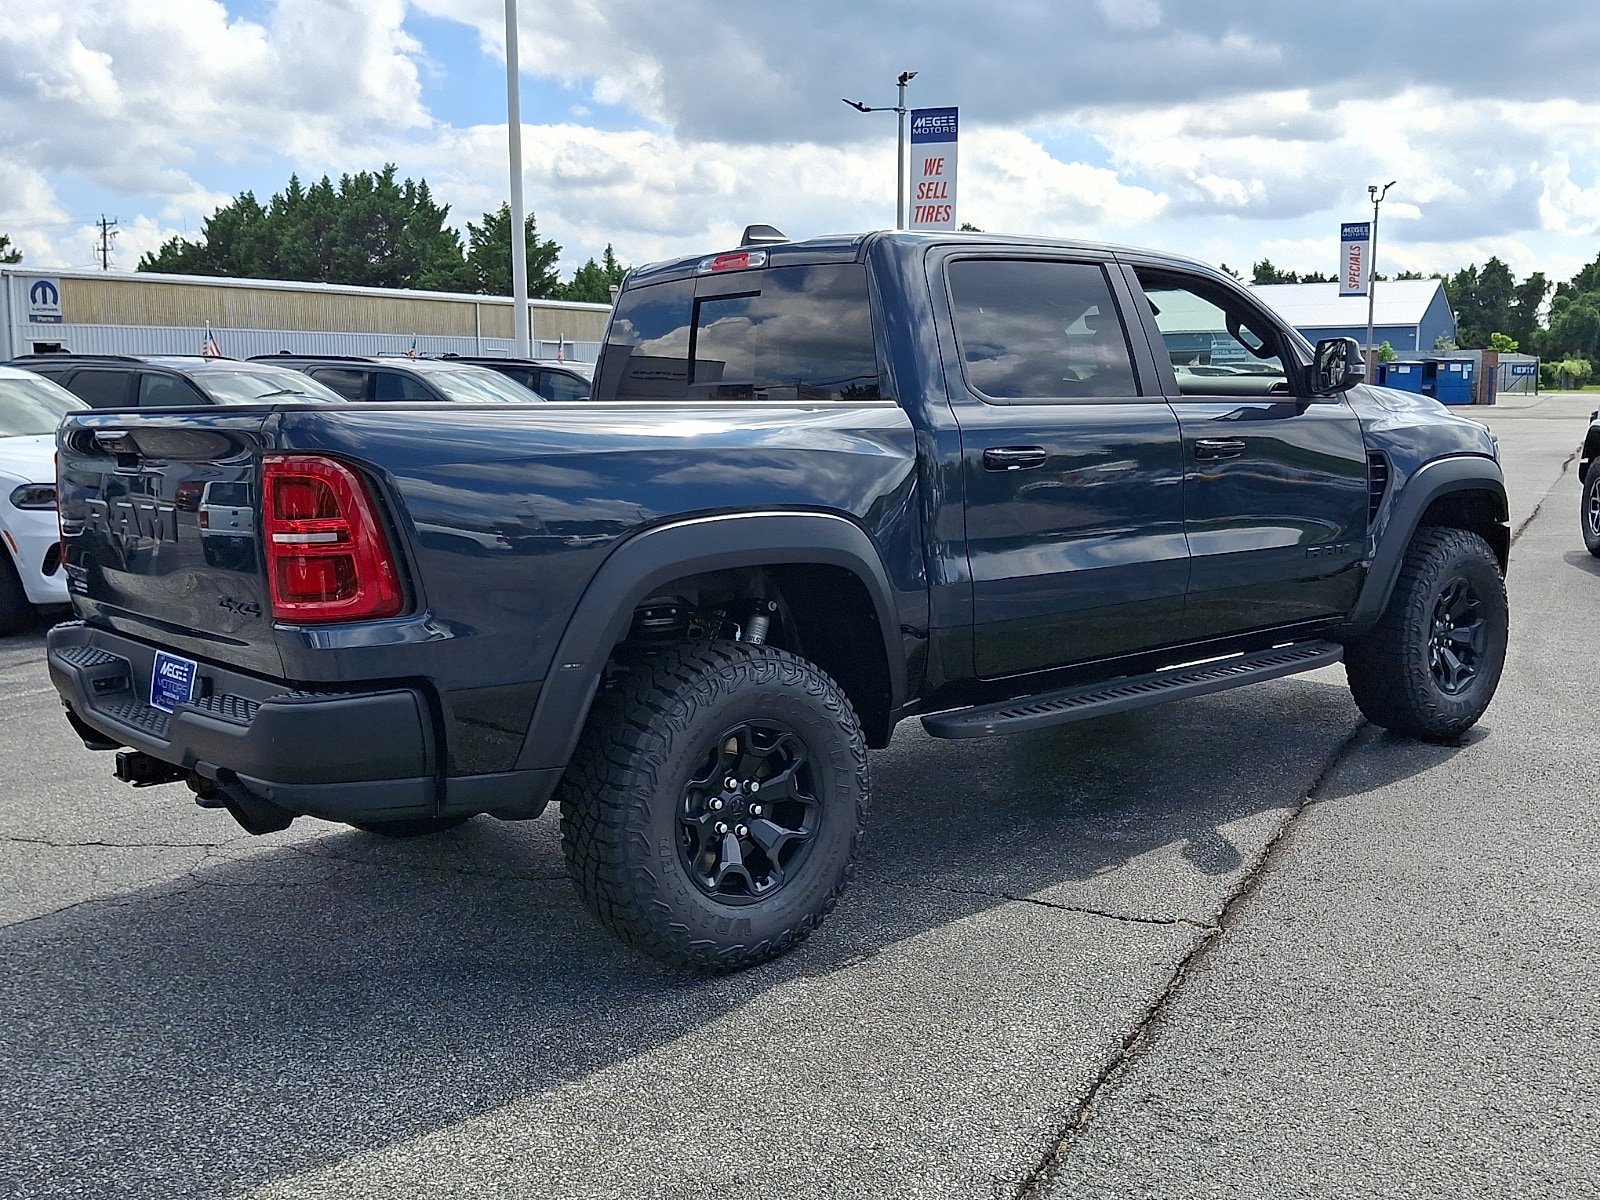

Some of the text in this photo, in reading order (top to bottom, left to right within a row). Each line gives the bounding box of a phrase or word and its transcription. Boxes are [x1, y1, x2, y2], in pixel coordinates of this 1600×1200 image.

[912, 126, 957, 135] MOTORS
[913, 115, 956, 127] MEGEE
[923, 157, 945, 176] WE
[916, 181, 948, 200] SELL
[914, 204, 952, 223] TIRES
[1348, 245, 1361, 290] SPECIALS
[84, 498, 179, 544] RAM
[159, 661, 189, 682] MEGEE
[157, 676, 188, 696] MOTORS
